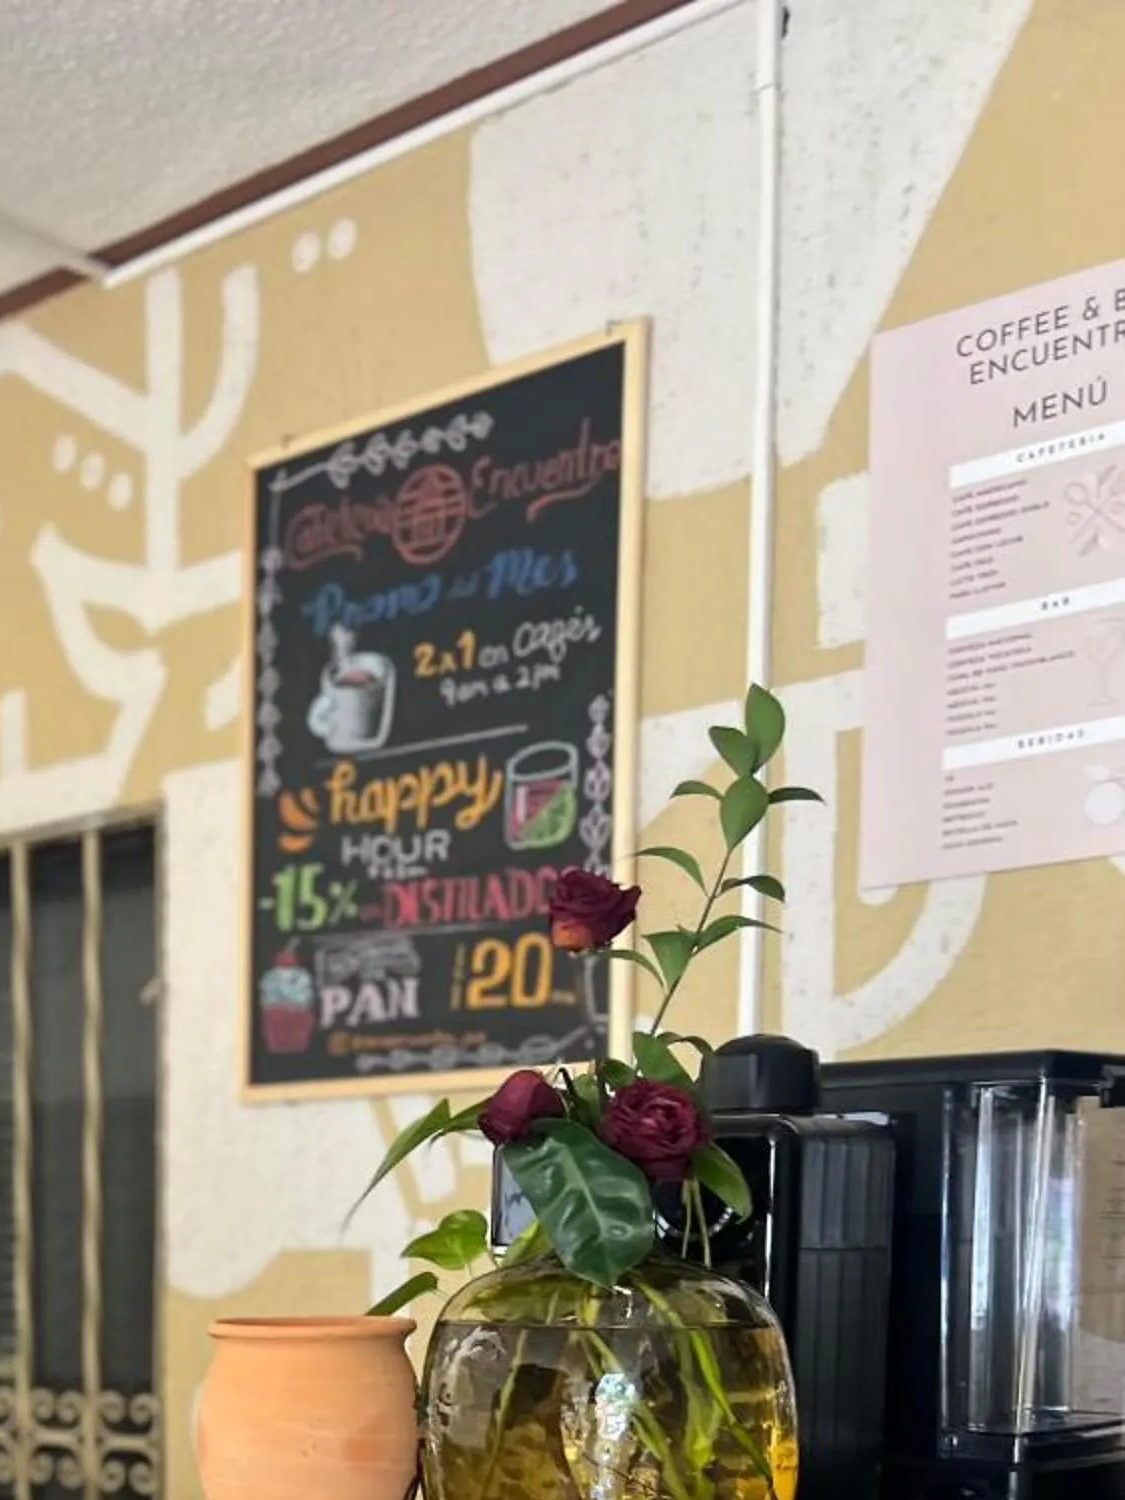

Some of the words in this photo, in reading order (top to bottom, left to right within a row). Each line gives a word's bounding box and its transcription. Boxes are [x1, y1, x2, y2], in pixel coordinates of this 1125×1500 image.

[956, 304, 1070, 358] COFFEE
[1082, 295, 1101, 321] &
[1012, 376, 1108, 429] MENÚ
[413, 629, 475, 678] 2x1
[325, 754, 505, 833] happy
[341, 829, 451, 866] HOUR
[320, 977, 421, 1028] PAN
